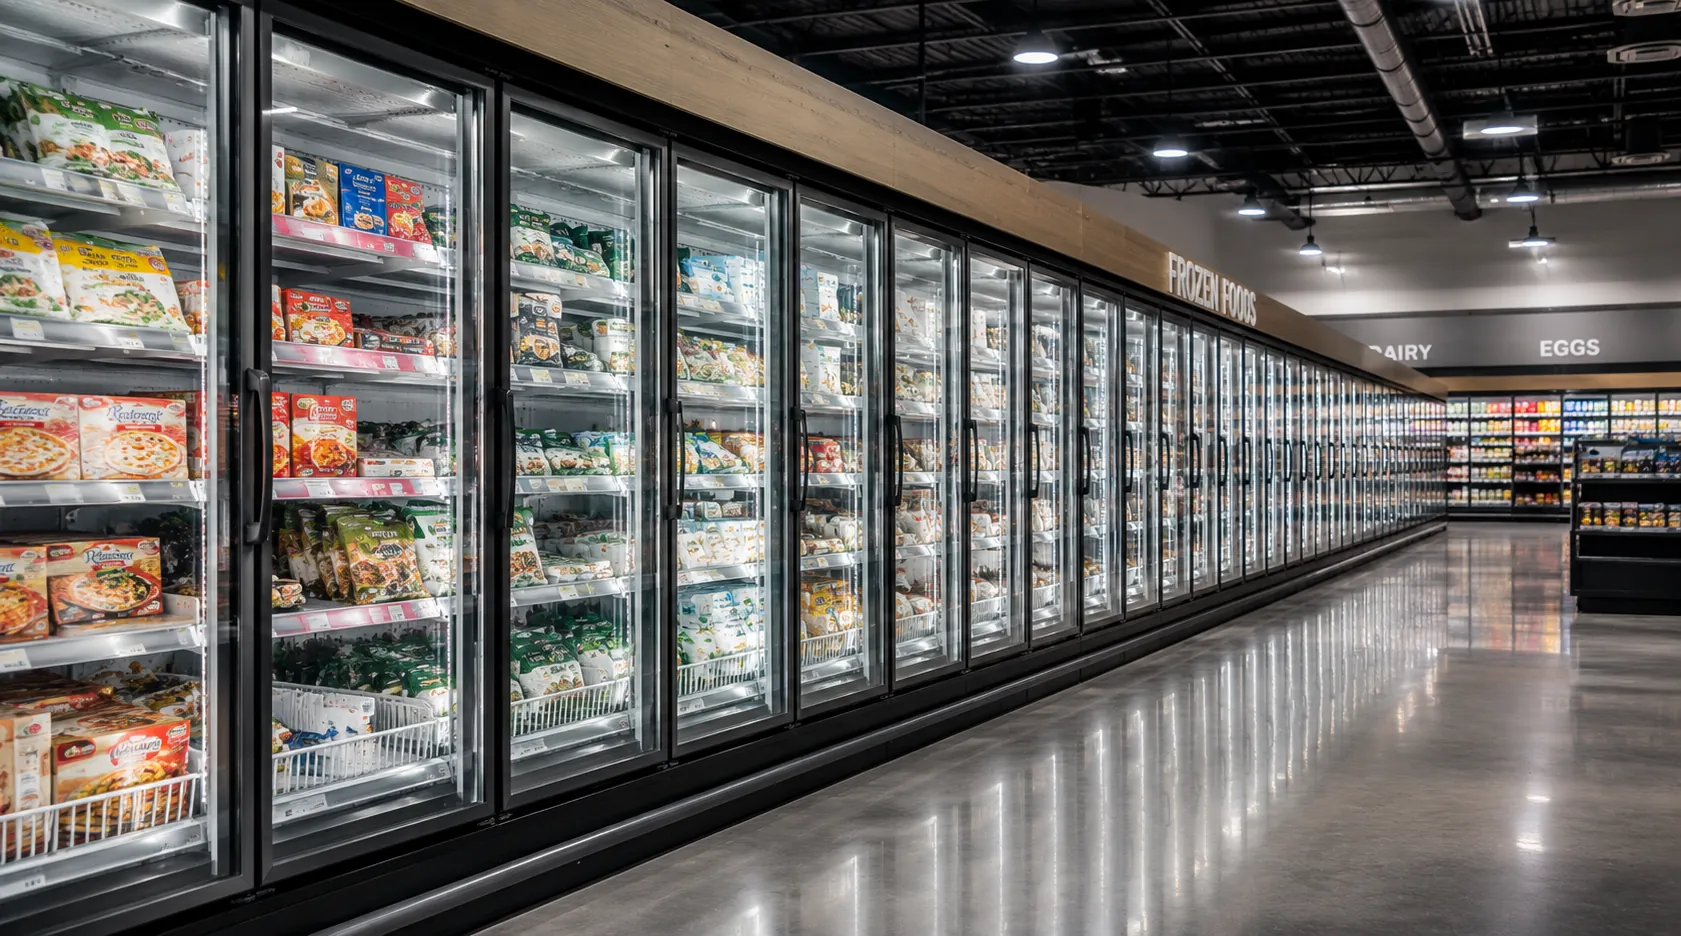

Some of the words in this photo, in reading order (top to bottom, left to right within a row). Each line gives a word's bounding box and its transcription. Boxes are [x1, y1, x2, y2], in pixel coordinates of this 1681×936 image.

[1168, 251, 1219, 311] FROZEN
[1222, 277, 1257, 326] FOODS
[1540, 339, 1600, 357] EGGS
